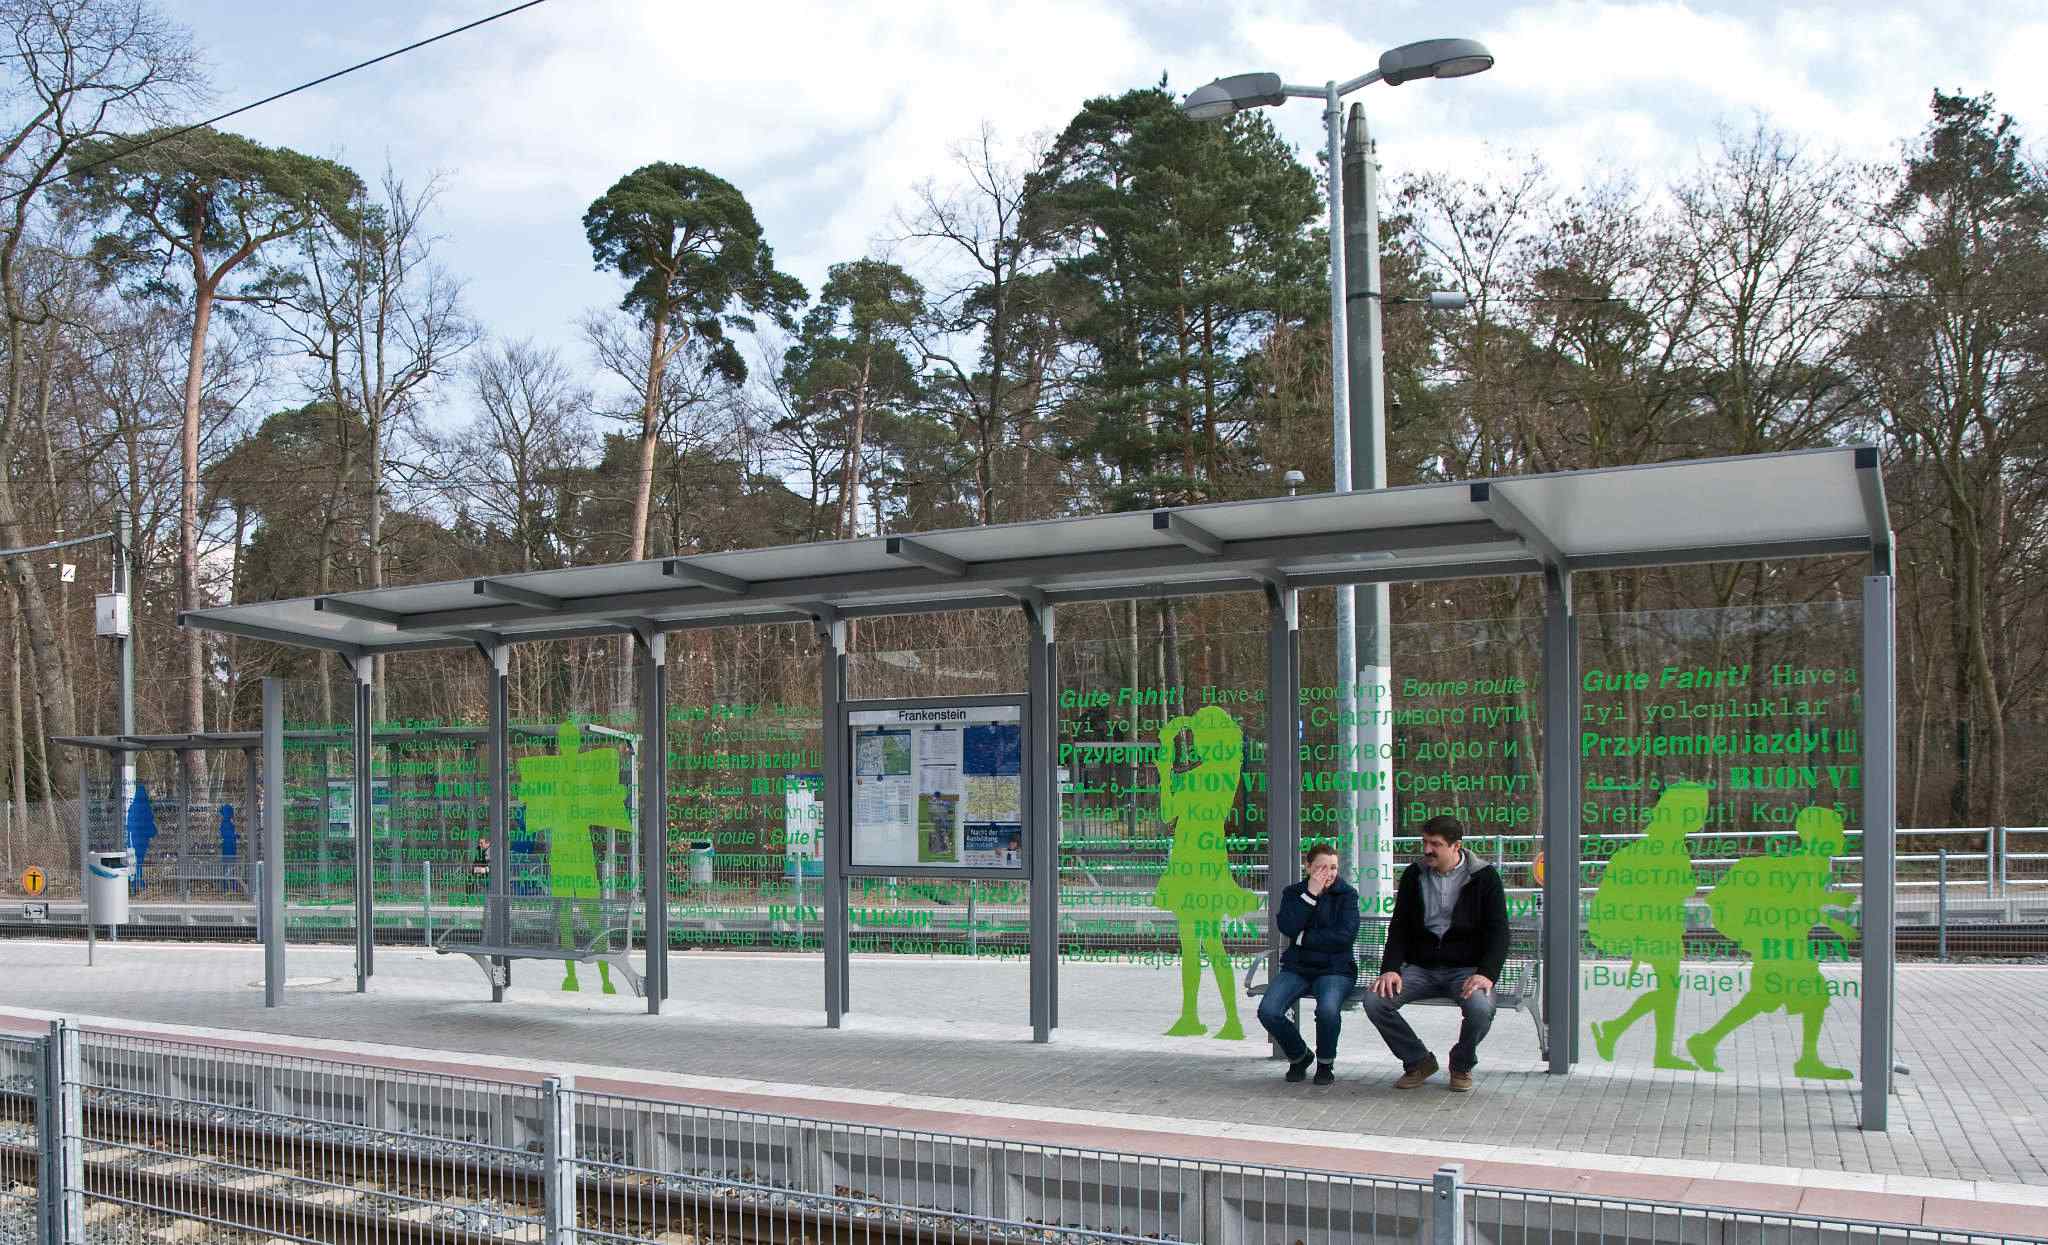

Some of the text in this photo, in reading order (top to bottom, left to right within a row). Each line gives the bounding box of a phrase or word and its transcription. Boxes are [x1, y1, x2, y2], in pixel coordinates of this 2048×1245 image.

[1403, 678, 1467, 697] Bonne
[1473, 677, 1526, 696] route
[1584, 664, 1857, 692] Gute Fahrt! Have a
[1059, 688, 1111, 708] Gute
[1116, 686, 1185, 706] Fahrt!
[1200, 685, 1249, 704] Have
[898, 709, 967, 722] Frankenstein
[1311, 706, 1465, 733] Счастливого
[1645, 697, 1828, 725] yolculuklar
[1396, 770, 1484, 798] Срећан
[1729, 766, 1818, 790] BUON
[1583, 801, 1670, 824] Sretan
[1583, 965, 1744, 996] ¡Buen viaje!
[1764, 972, 1858, 998] Sretan
